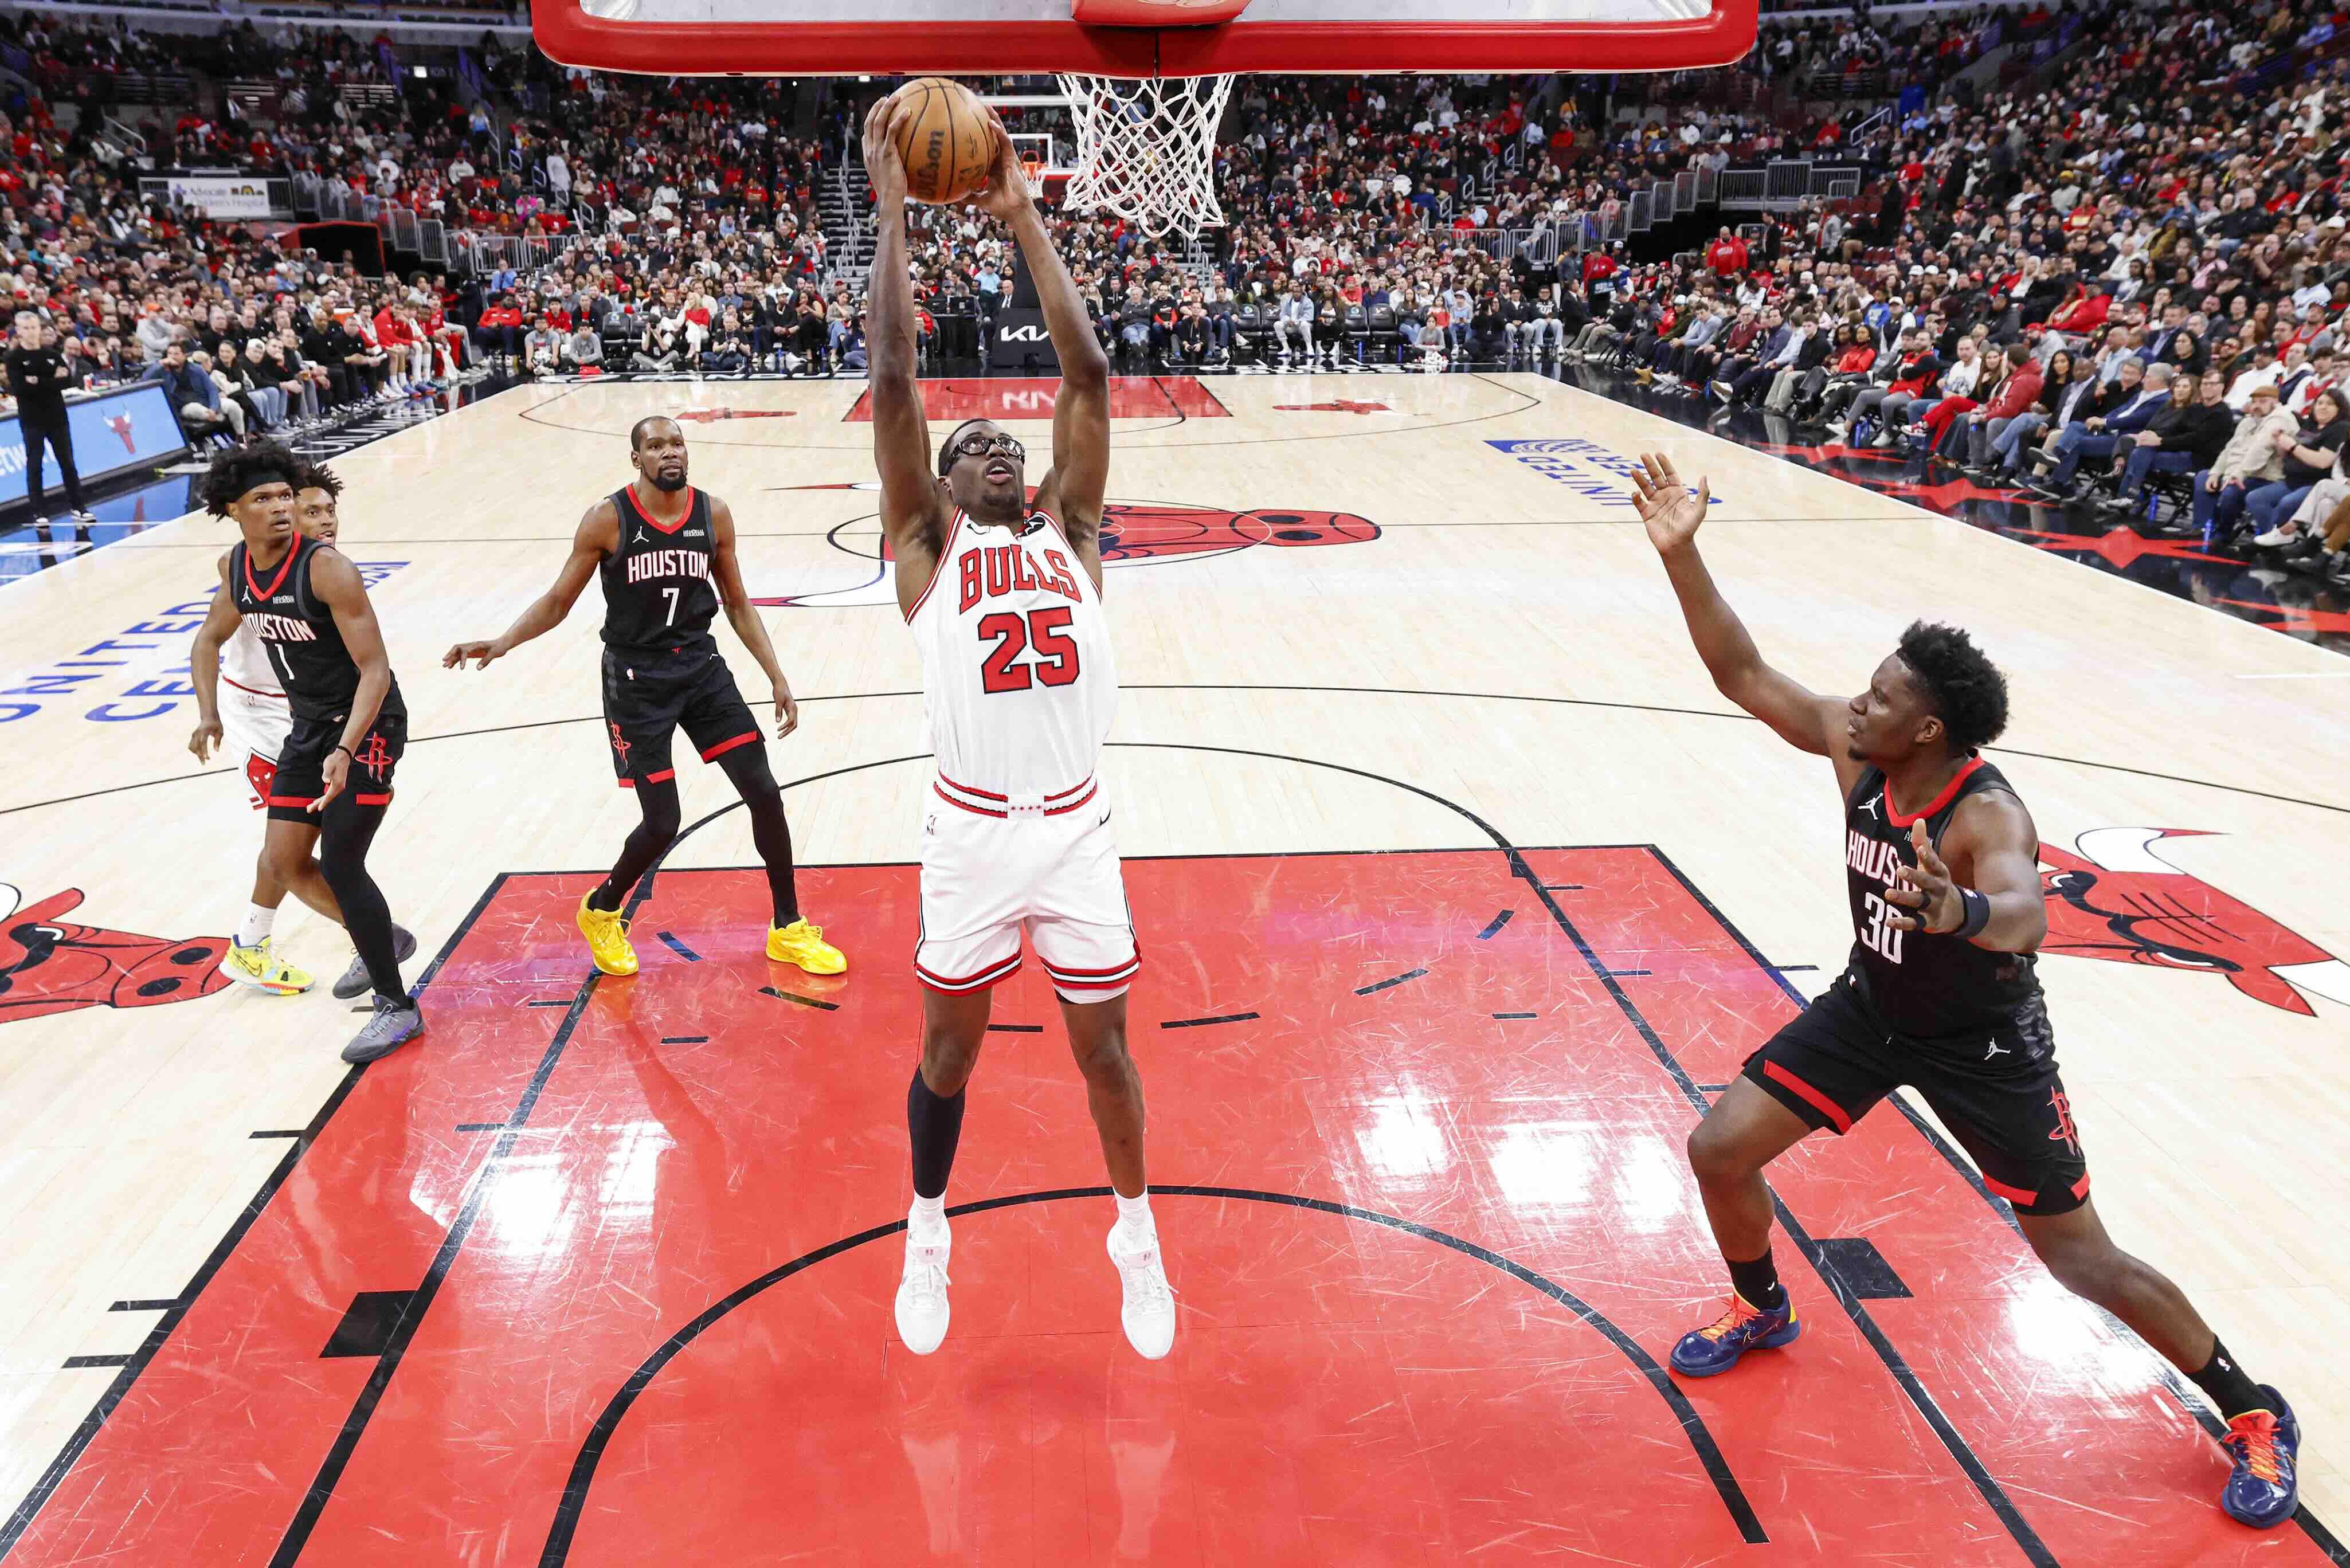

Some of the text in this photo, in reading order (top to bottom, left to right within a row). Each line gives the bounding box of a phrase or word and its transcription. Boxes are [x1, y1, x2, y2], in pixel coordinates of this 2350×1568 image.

[1001, 325, 1049, 342] KI
[628, 549, 708, 583] HOUSTON
[959, 543, 1082, 615] BULLS
[662, 587, 680, 626] 7
[274, 642, 295, 680] 1
[977, 606, 1080, 695] 25
[1861, 891, 1903, 964] 30
